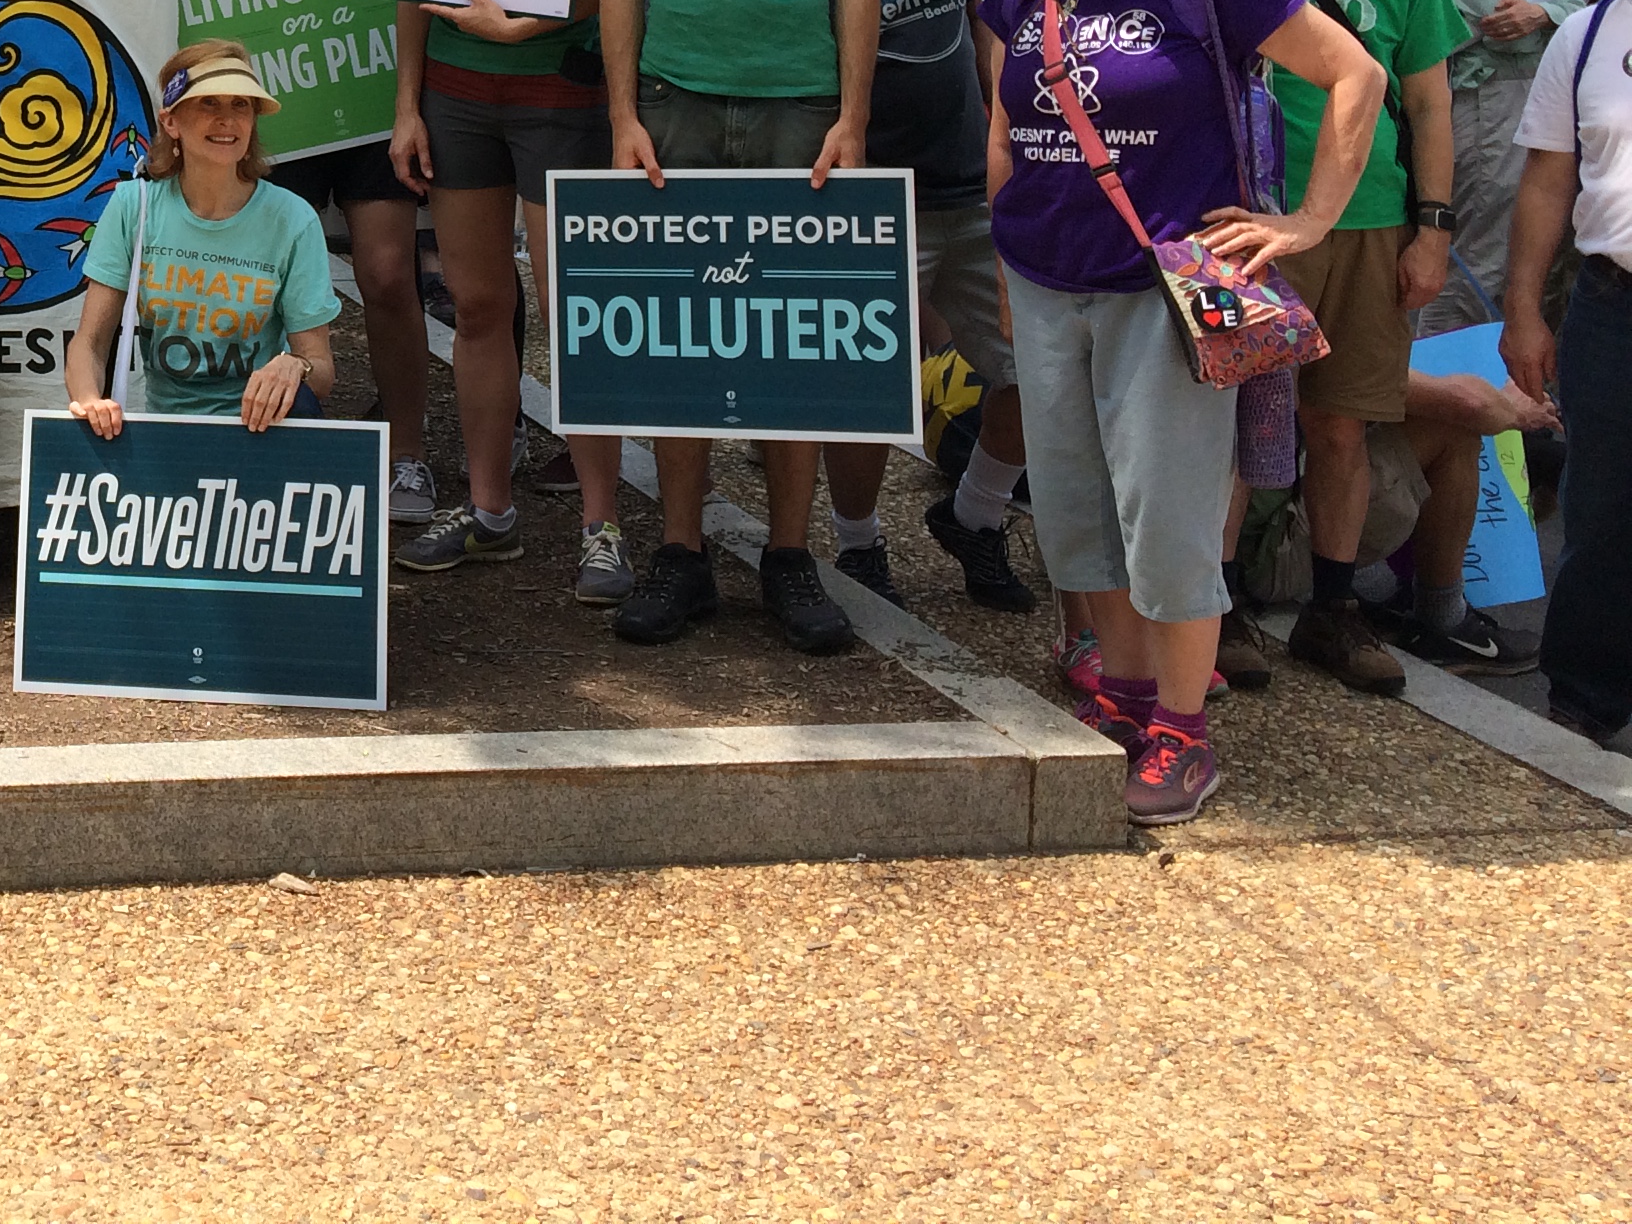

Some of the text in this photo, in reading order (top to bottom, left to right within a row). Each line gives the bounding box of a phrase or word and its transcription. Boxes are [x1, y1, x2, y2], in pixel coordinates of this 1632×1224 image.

[282, 6, 355, 35] on a
[323, 24, 398, 83] PLA
[1104, 130, 1158, 145] WHAT
[564, 215, 896, 245] PROTECT PEOPLE
[142, 246, 276, 274] OTECT OUR COMMUNITIES
[702, 251, 754, 284] not
[138, 298, 268, 340] CTION
[566, 295, 899, 363] POLLUTERS
[158, 335, 261, 378] OW
[36, 472, 366, 576] #SaveTheEPA
[1477, 481, 1508, 528] the
